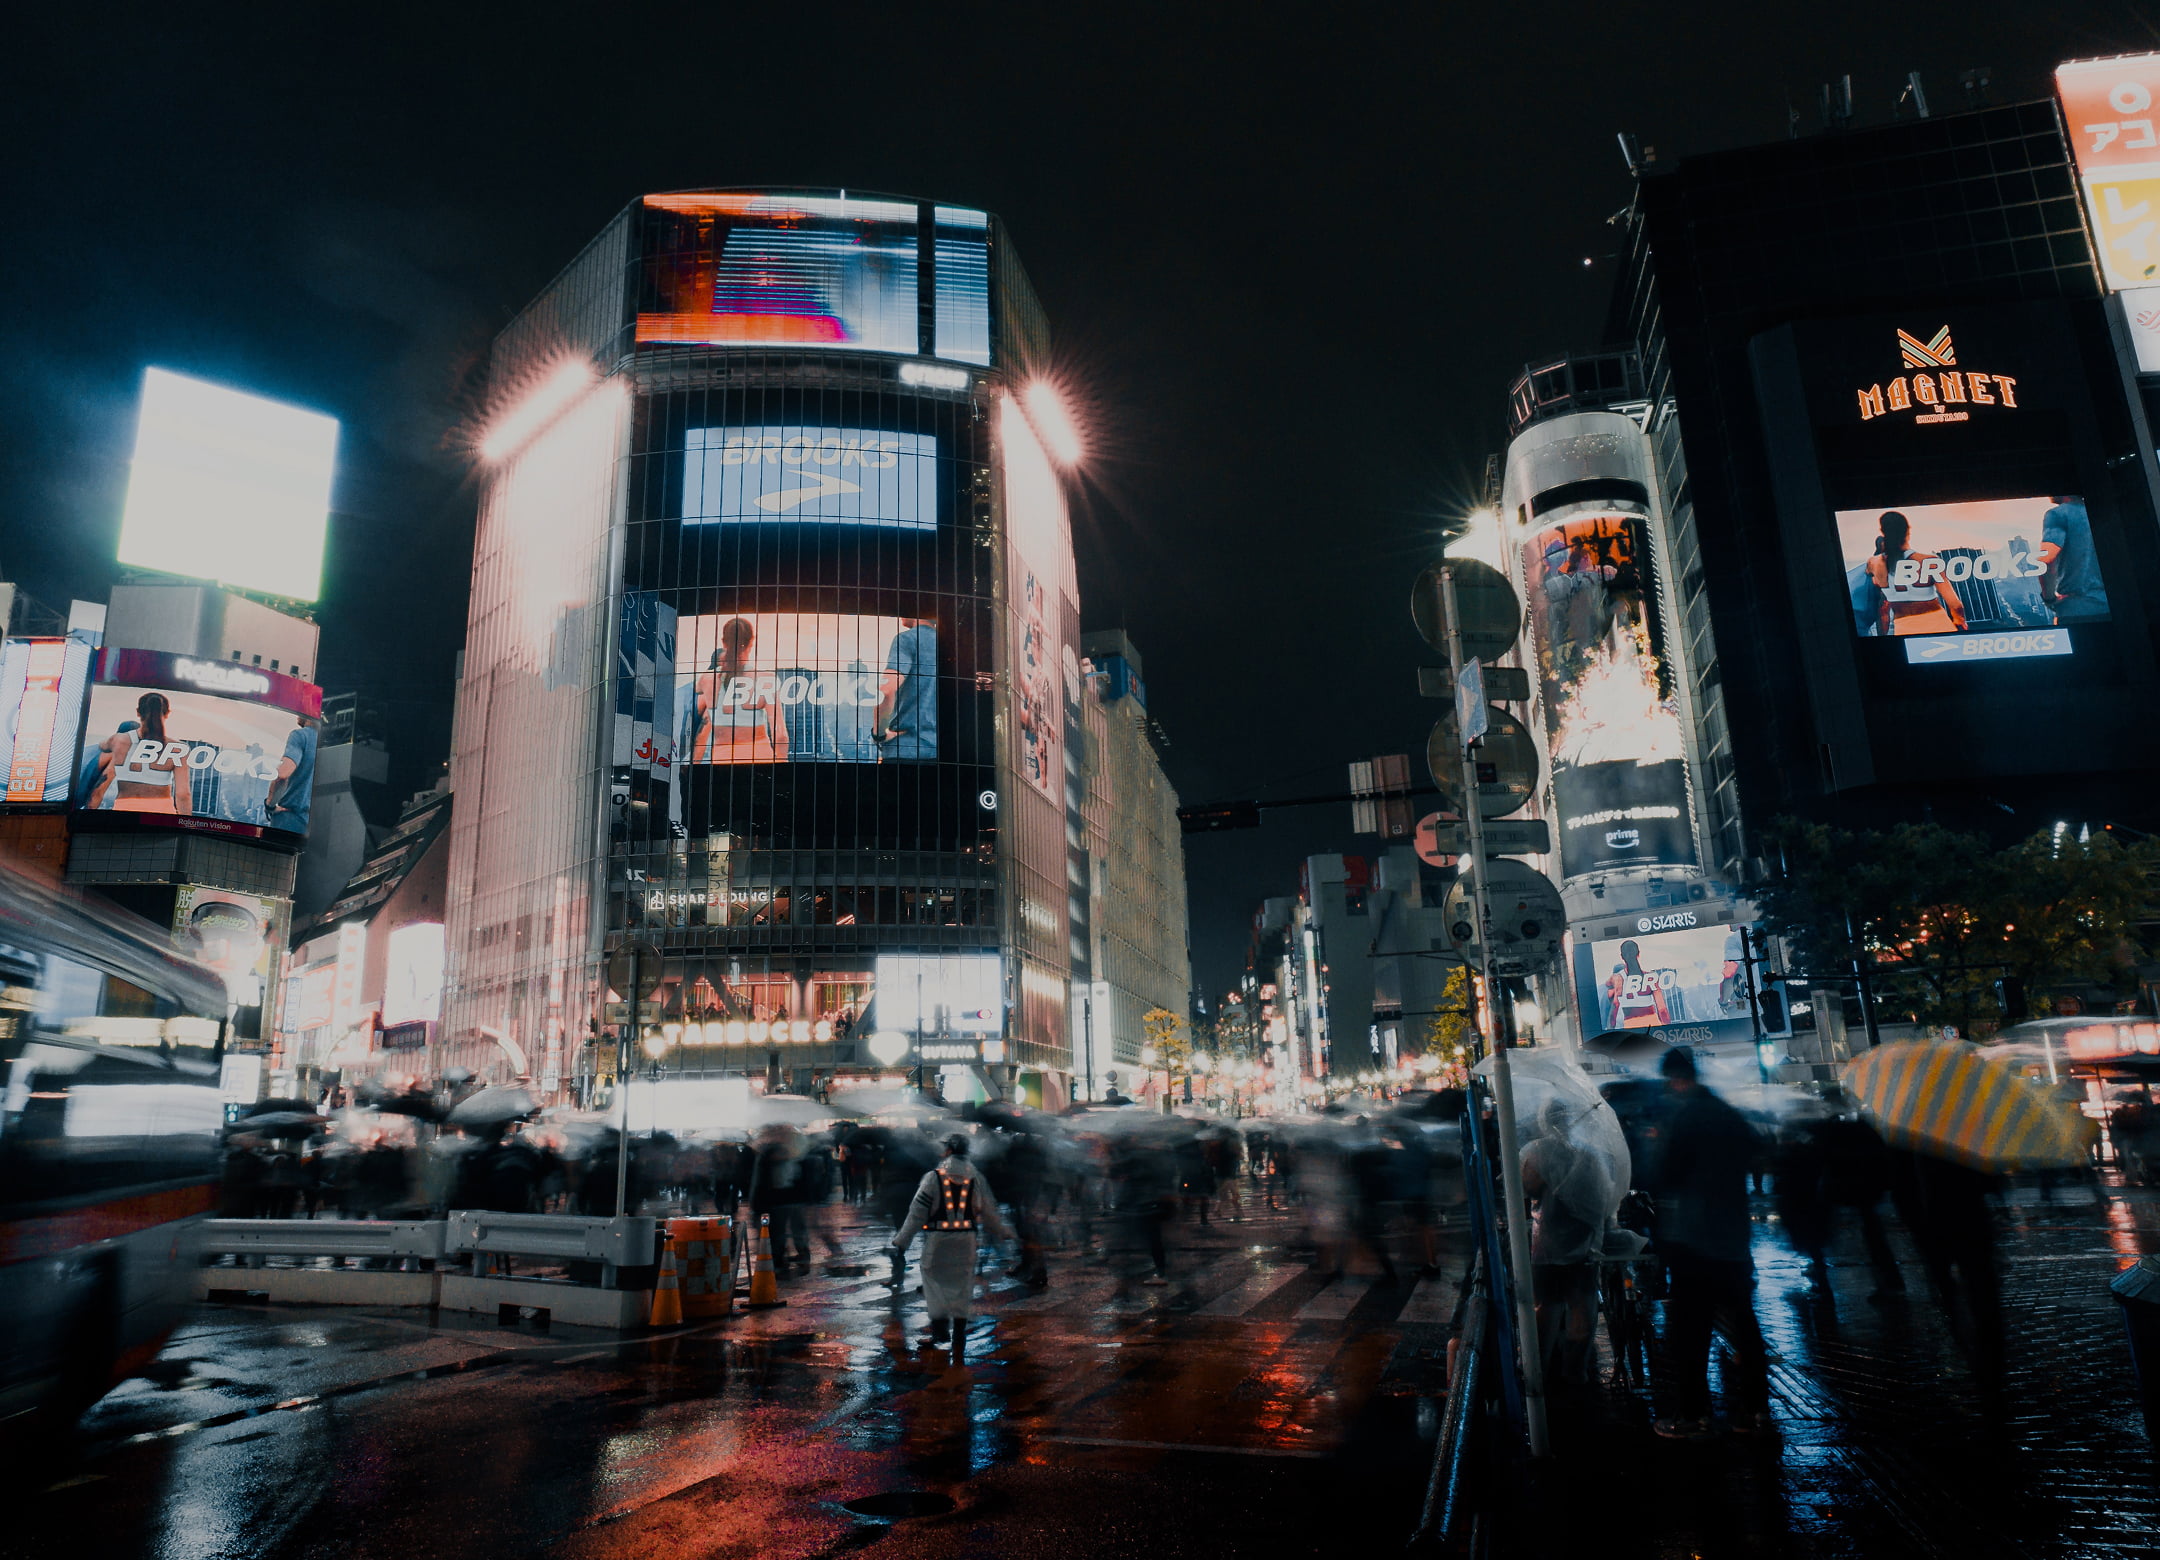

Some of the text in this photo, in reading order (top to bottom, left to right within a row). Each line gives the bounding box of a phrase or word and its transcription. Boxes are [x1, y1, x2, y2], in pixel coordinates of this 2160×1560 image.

[2084, 119, 2160, 152] アコ
[1857, 372, 2018, 420] MAGNET
[720, 436, 903, 468] BROOKS
[1894, 550, 2050, 586] BROOKS
[1962, 634, 2056, 655] BROOKS
[174, 658, 270, 694] Rakuten
[722, 675, 889, 707] BROOKS
[130, 739, 283, 781] BROOKS
[178, 818, 231, 831] Rakuten Vision
[1606, 829, 1639, 841] prime
[669, 892, 714, 905] SHARE
[1626, 960, 1725, 994] BRO
[643, 1020, 832, 1046] TAUCKS
[912, 1045, 977, 1060] SUTAYA
